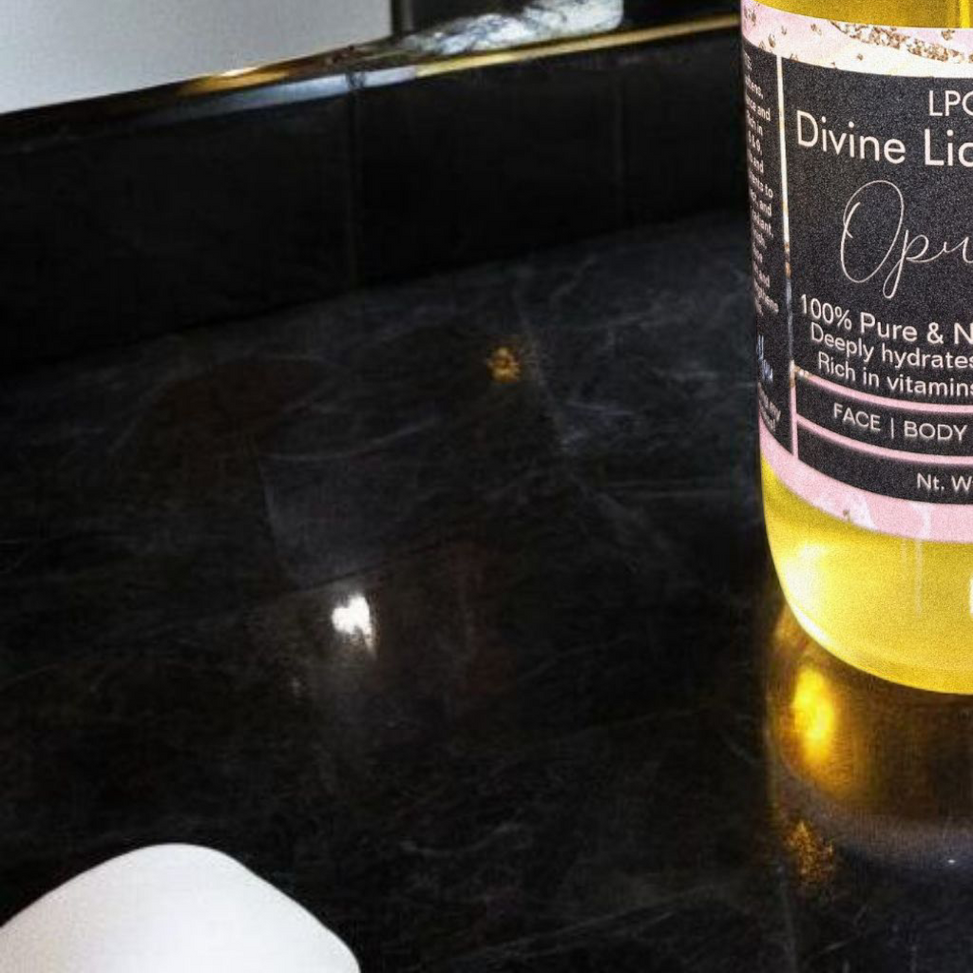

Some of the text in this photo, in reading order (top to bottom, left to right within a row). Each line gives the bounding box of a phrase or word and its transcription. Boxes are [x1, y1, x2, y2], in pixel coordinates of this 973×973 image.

[796, 109, 906, 165] Divine
[800, 293, 853, 331] 100%
[860, 311, 918, 343] Pure
[926, 322, 944, 344] &
[810, 322, 875, 364] Deeply
[818, 352, 856, 382] Rich
[862, 367, 879, 387] in
[833, 403, 880, 432] FACE
[904, 419, 967, 442] BODY
[916, 472, 944, 492] Nt.
